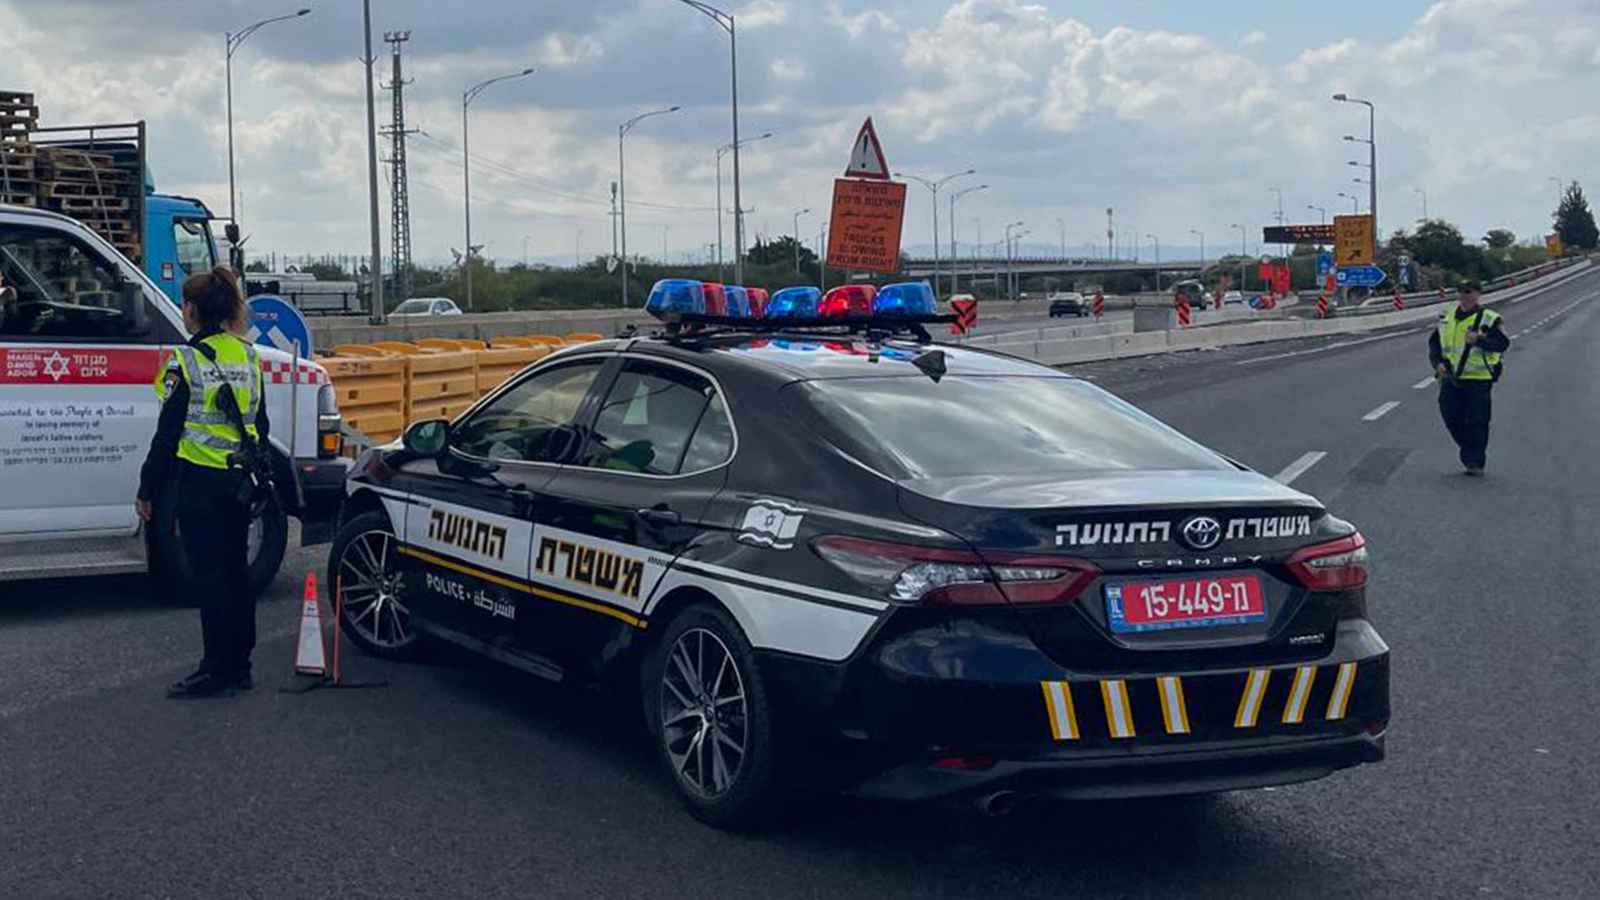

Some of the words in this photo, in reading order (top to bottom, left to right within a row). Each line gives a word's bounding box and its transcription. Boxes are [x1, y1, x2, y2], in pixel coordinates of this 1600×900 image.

[843, 233, 885, 246] TRUCKS
[7, 353, 42, 361] MAGEN
[7, 361, 35, 369] DAVID
[65, 404, 92, 419] People
[427, 508, 507, 561] התנועה
[1055, 521, 1171, 546] התנועה
[1225, 515, 1311, 540] משטרת
[534, 535, 645, 599] משטרת
[1136, 554, 1262, 568] CAMRY
[426, 573, 465, 601] POLICE
[473, 590, 516, 619] الشرطة
